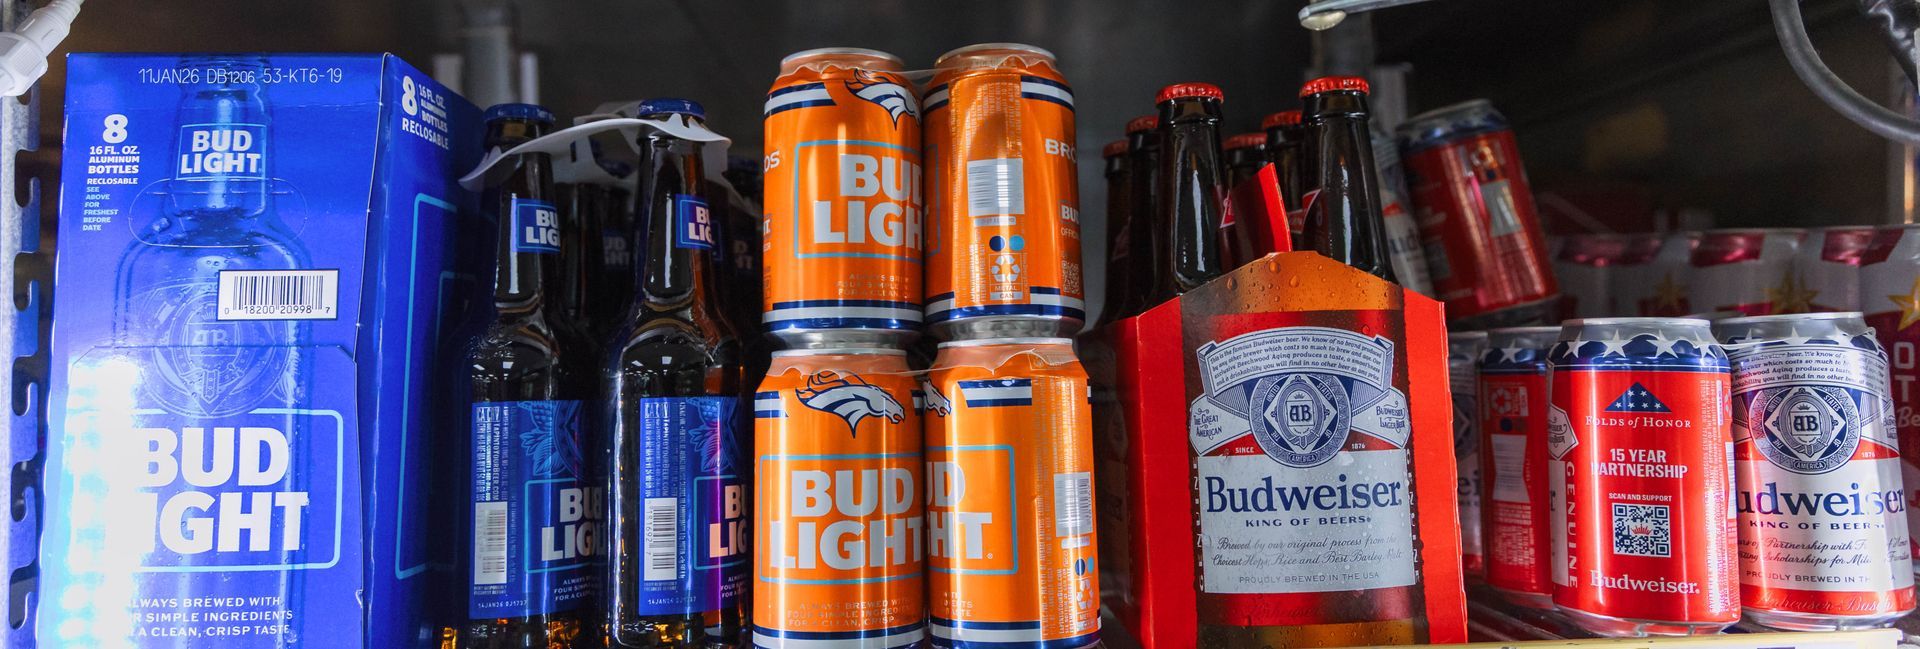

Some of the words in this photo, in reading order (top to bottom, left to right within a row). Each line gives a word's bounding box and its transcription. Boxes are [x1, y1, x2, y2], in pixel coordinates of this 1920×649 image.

[138, 68, 200, 84] 11JAN26
[263, 68, 343, 84] 53-KT6-19
[402, 76, 418, 116] 8
[102, 114, 128, 144] 8
[402, 118, 449, 150] RECLOSABLE
[192, 130, 252, 152] BUD
[89, 146, 103, 155] 16
[104, 146, 120, 155] FL.
[122, 145, 140, 155] OZ.
[88, 165, 139, 174] BOTTLES
[180, 153, 261, 174] LIGHT
[815, 200, 923, 251] LIGH
[244, 306, 275, 315] 18200
[280, 306, 312, 314] 20998
[325, 306, 331, 314] 7
[1264, 345, 1282, 353] which
[1292, 351, 1322, 359] produces
[1321, 360, 1337, 368] other
[1764, 359, 1784, 367] which
[1316, 384, 1333, 400] STATES
[1823, 395, 1842, 412] STATES
[1586, 415, 1625, 427] FOLDS
[1627, 416, 1641, 428] of
[1643, 416, 1692, 428] HONOR
[131, 427, 289, 488] BUD
[1235, 446, 1255, 454] SINCE
[1610, 448, 1626, 462] 15
[1628, 449, 1667, 463] YEAR
[1591, 462, 1688, 479] PARTNERSHIP
[791, 468, 914, 517] BUD
[1608, 492, 1626, 500] SCAN
[1737, 482, 1905, 516] udweiser
[134, 491, 309, 555] IGHT
[1246, 518, 1282, 527] KING
[1290, 517, 1311, 526] OF
[1566, 461, 1578, 588] GENUINE
[1750, 521, 1789, 529] KING
[1799, 522, 1821, 530] OF
[770, 517, 922, 570] LIGHT
[1217, 537, 1252, 550] Brewed
[1287, 538, 1328, 554] original
[1329, 538, 1362, 550] process
[1766, 537, 1829, 553] Partnership
[1830, 540, 1853, 551] with
[1212, 554, 1243, 566] Choicest
[1299, 555, 1320, 564] and
[1322, 550, 1349, 563] Best
[1829, 554, 1845, 568] for
[1284, 574, 1326, 583] BREWED
[1363, 571, 1380, 579] USA
[1795, 574, 1841, 583] BREWED
[184, 597, 245, 608] BREWED
[249, 597, 280, 607] WITH
[146, 612, 199, 623] SIMPLE
[204, 611, 293, 621] INGREDIENTS
[152, 627, 202, 638] CLEAN,
[206, 626, 251, 636] CRISP
[254, 624, 290, 635] TASTE
